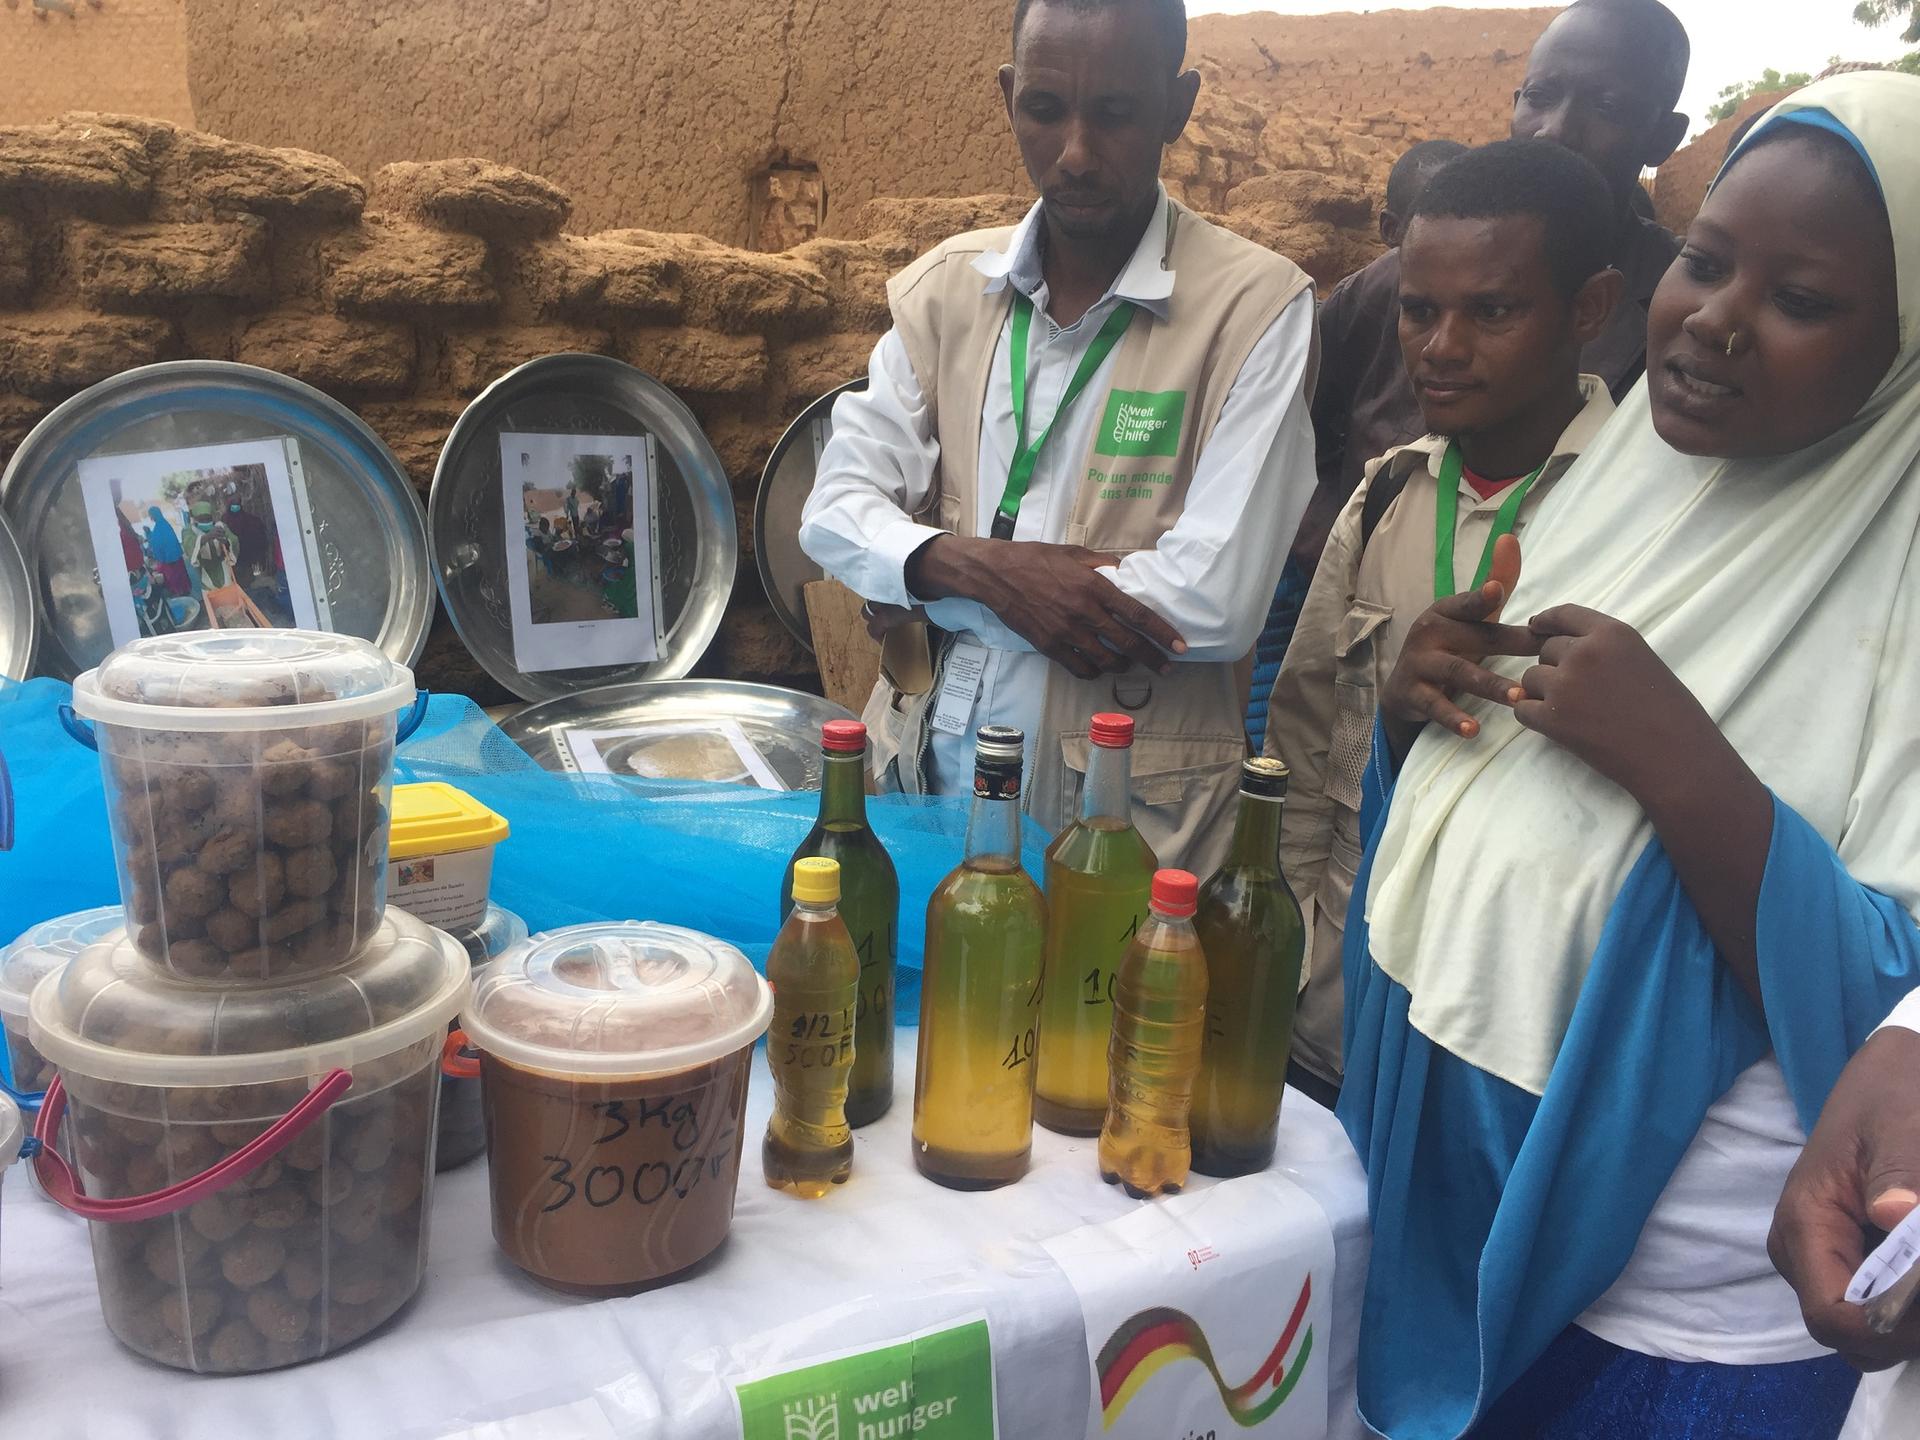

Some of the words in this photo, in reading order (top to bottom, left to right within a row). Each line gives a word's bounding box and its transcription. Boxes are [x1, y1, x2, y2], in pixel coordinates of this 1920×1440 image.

[1128, 406, 1155, 417] welt
[1127, 417, 1167, 431] hunger
[1124, 431, 1151, 442] hilfe
[1131, 471, 1174, 486] monde
[593, 1101, 629, 1145] 3
